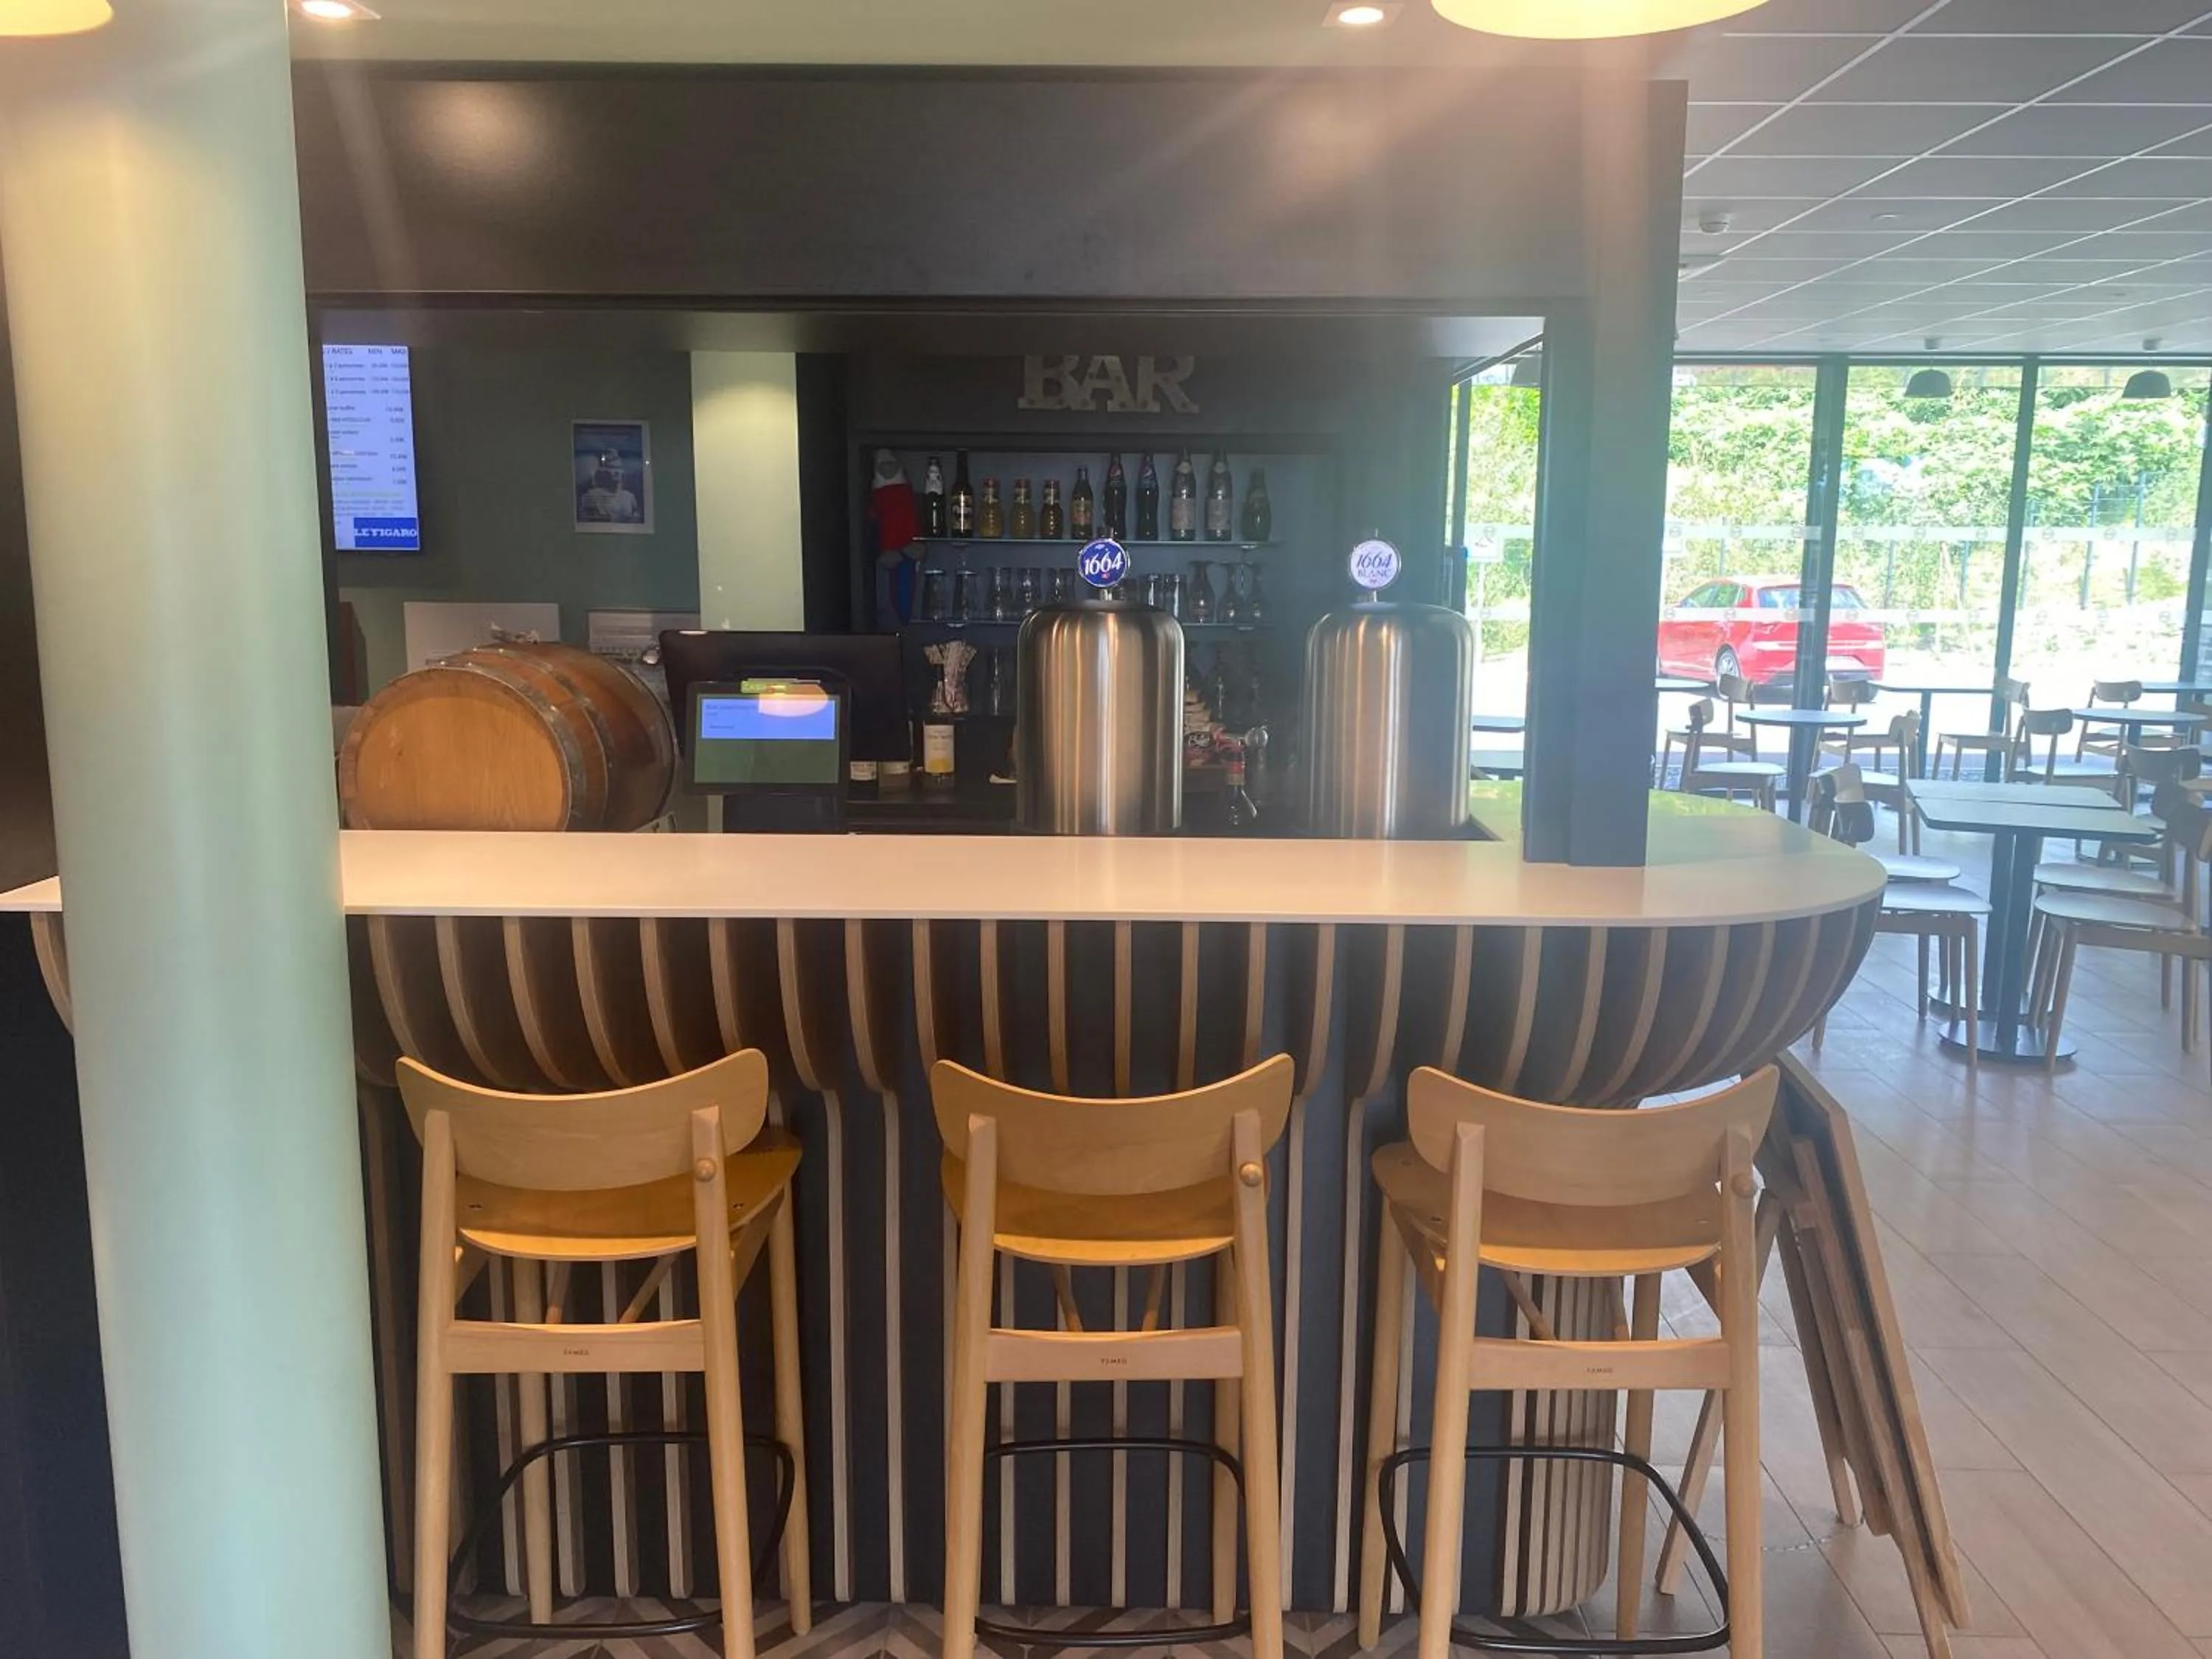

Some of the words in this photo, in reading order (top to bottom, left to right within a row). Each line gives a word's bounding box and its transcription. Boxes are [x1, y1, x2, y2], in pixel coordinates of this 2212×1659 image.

[1018, 355, 1200, 413] BAR
[371, 529, 417, 537] FIGARO
[1084, 550, 1124, 576] 1664
[1356, 551, 1393, 568] 1664
